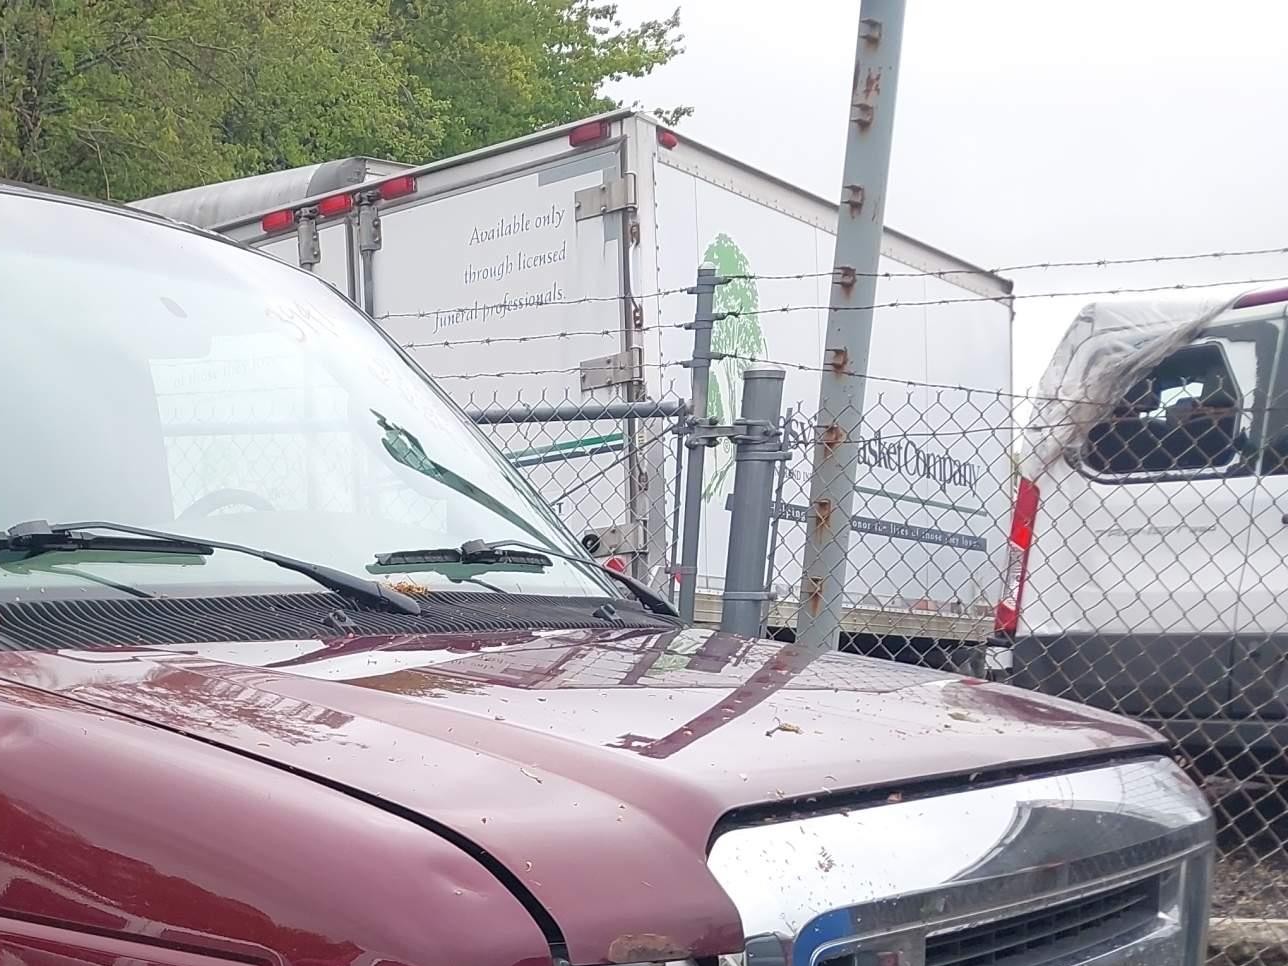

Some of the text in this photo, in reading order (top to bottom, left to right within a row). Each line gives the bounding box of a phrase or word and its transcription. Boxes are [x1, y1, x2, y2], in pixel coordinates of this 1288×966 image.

[469, 203, 566, 246] Available only
[464, 240, 567, 285] through licensed
[432, 282, 567, 334] funeral professionals.
[855, 430, 903, 473] asket
[903, 439, 982, 498] Company
